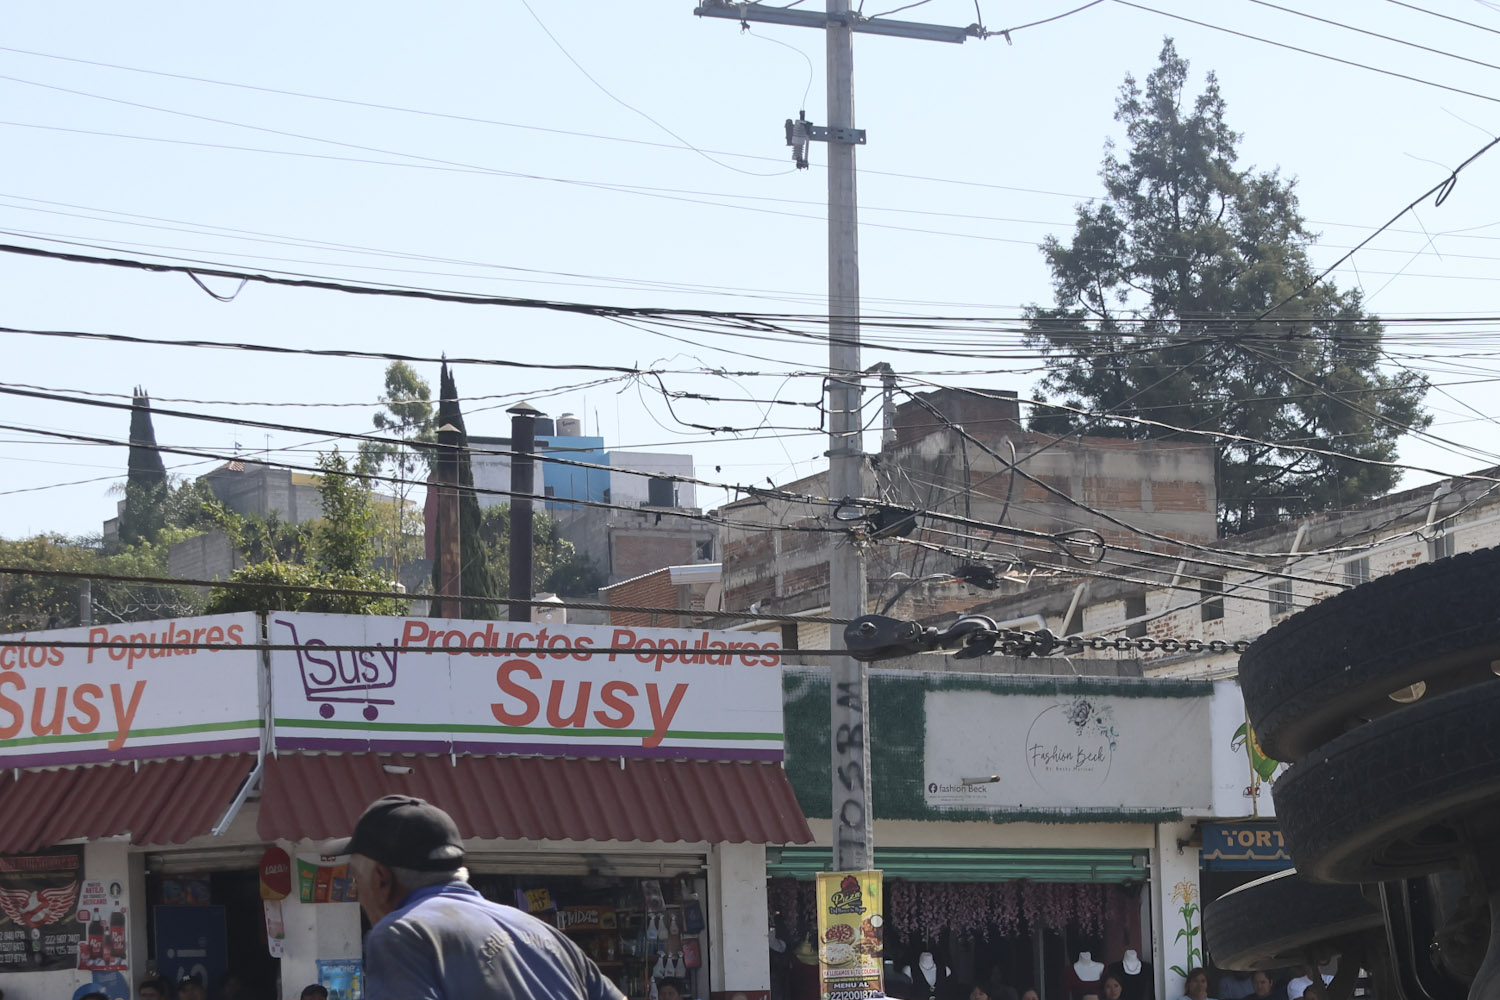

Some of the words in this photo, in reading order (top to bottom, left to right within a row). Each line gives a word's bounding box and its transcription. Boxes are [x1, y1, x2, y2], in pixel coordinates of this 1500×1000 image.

[87, 622, 245, 670] Populares
[304, 637, 399, 688] Susy
[400, 619, 595, 661] Productos
[607, 625, 781, 671] Populares
[0, 671, 147, 752] Susy
[490, 658, 690, 748] Susy
[1029, 743, 1074, 767] Fashion
[939, 783, 966, 793] fashion
[968, 783, 987, 793] Beck
